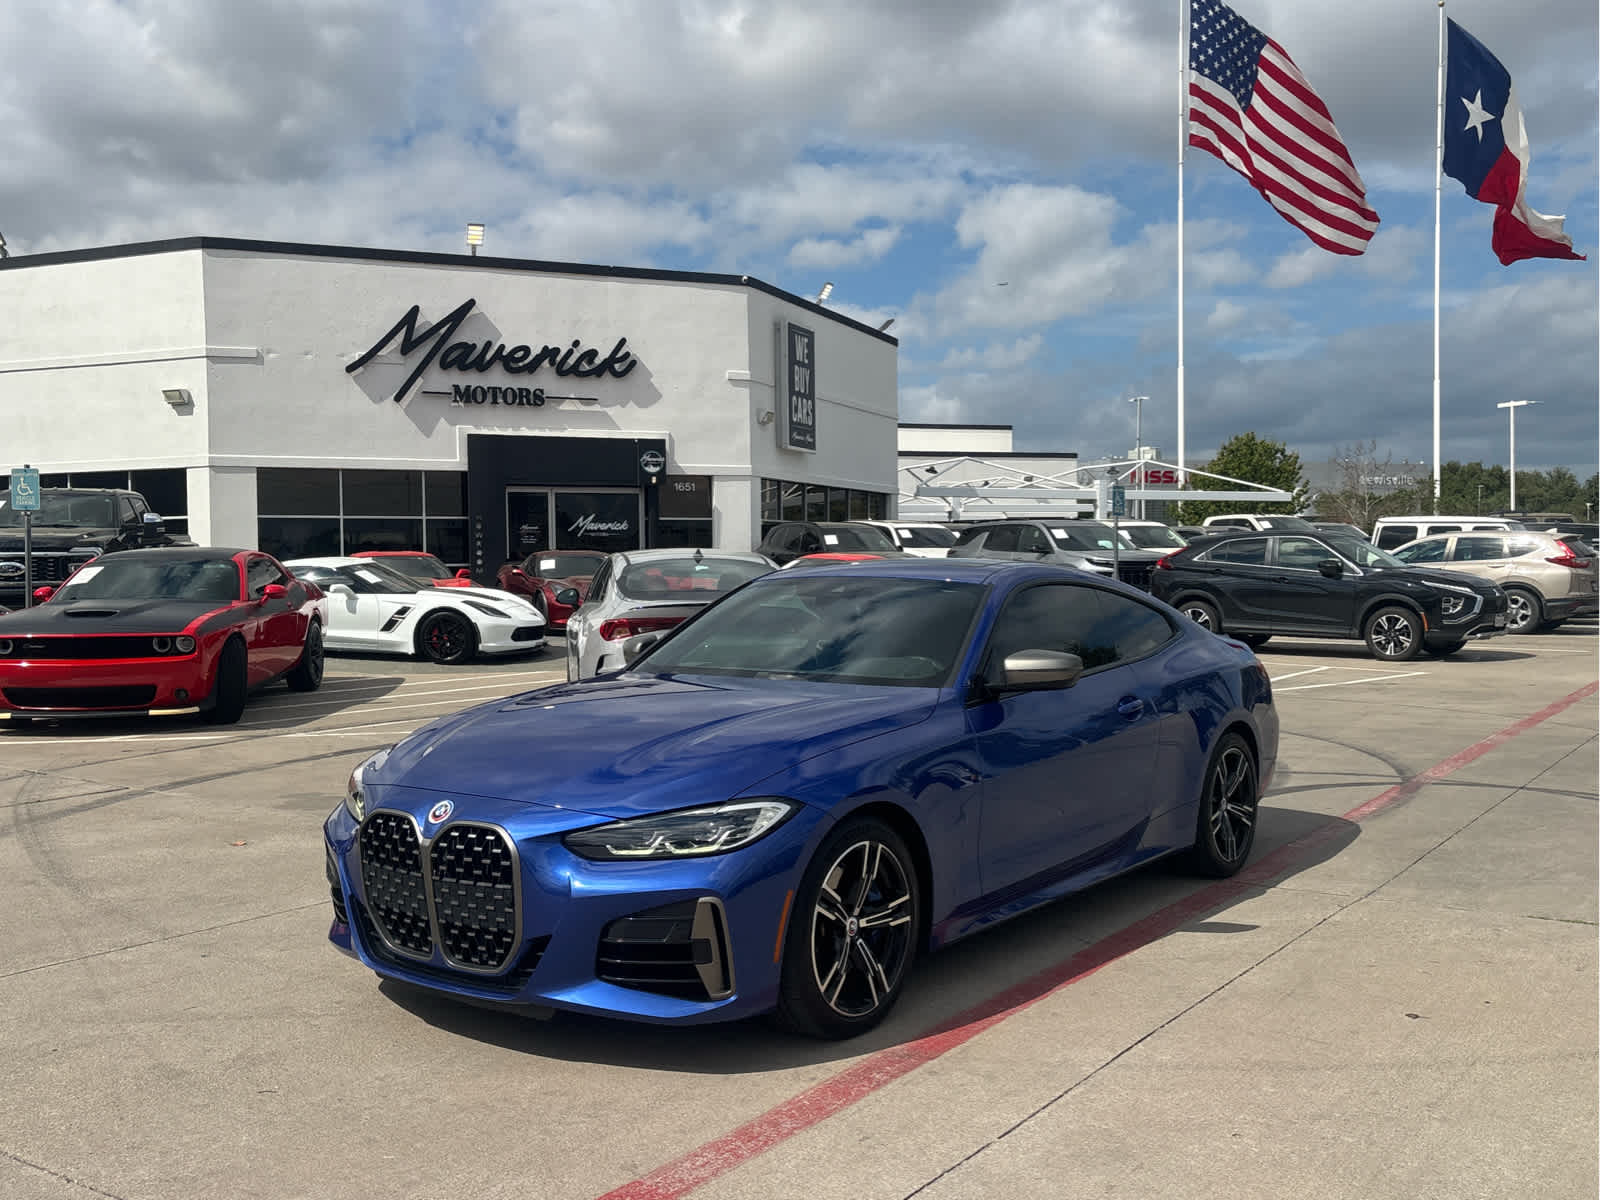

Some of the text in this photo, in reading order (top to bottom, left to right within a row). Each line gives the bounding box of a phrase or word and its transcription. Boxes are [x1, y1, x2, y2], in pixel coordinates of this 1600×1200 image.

[345, 298, 637, 402] Maverick
[794, 333, 809, 364] WE
[794, 364, 810, 394] BUY
[452, 384, 545, 407] MOTORS
[792, 395, 813, 426] CARS
[674, 482, 696, 492] 1651
[567, 513, 629, 537] Maverick
